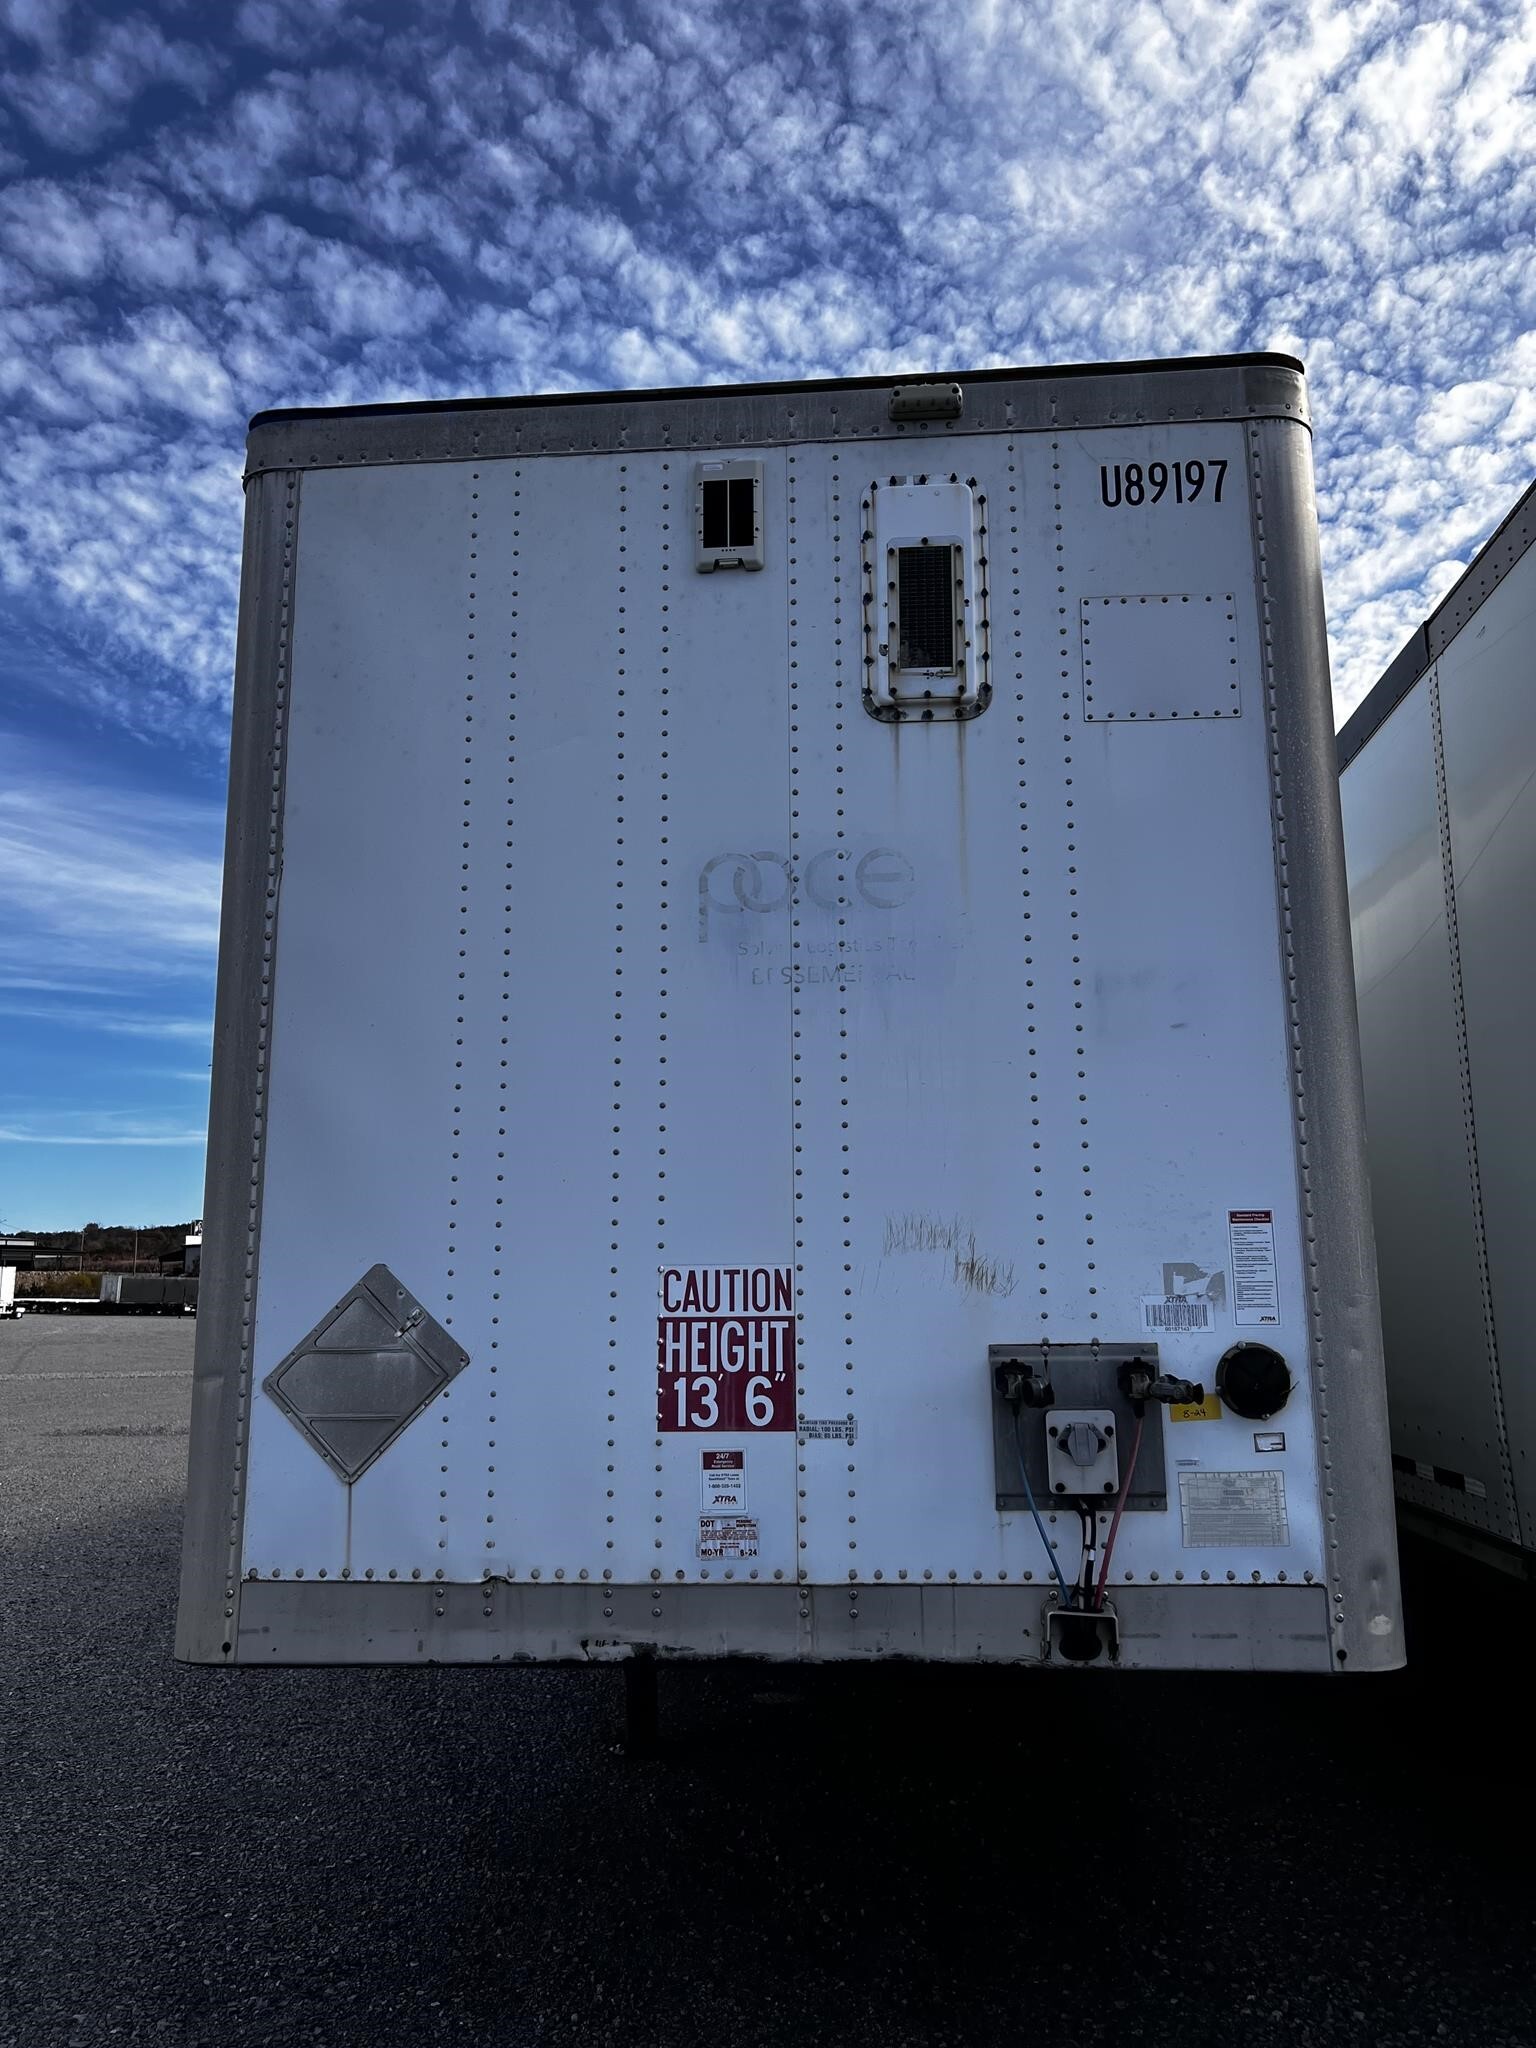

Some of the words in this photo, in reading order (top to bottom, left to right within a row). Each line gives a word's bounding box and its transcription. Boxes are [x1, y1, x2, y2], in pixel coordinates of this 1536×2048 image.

[1100, 459, 1228, 508] U89197
[663, 1268, 792, 1313] CAUTION
[665, 1321, 789, 1373] HEIGHT
[712, 1495, 737, 1504] XTRA
